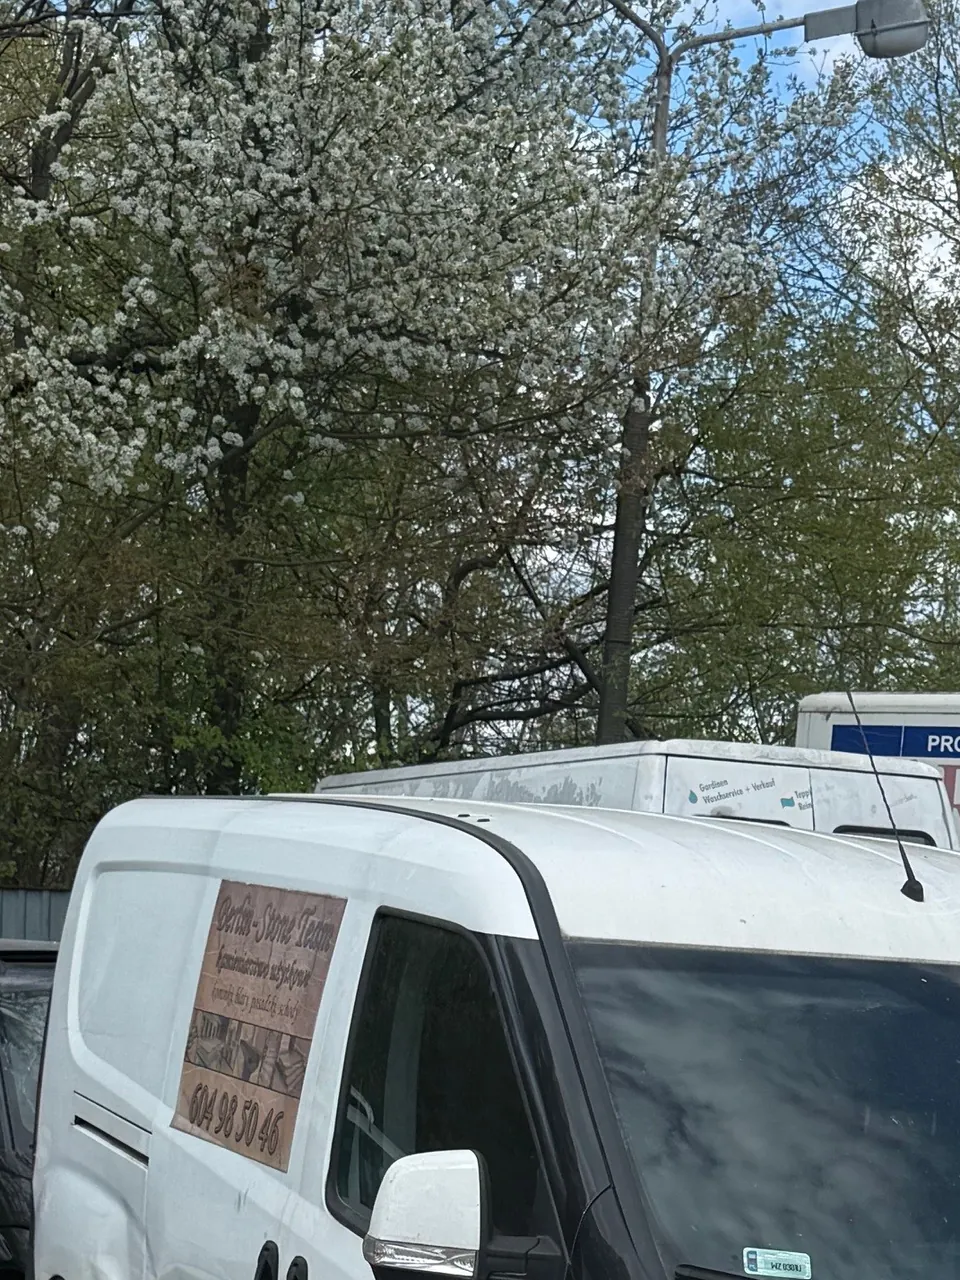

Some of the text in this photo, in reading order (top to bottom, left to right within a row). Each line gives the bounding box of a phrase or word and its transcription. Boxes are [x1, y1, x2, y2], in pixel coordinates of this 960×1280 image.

[189, 1081, 285, 1156] 604 98 50 46
